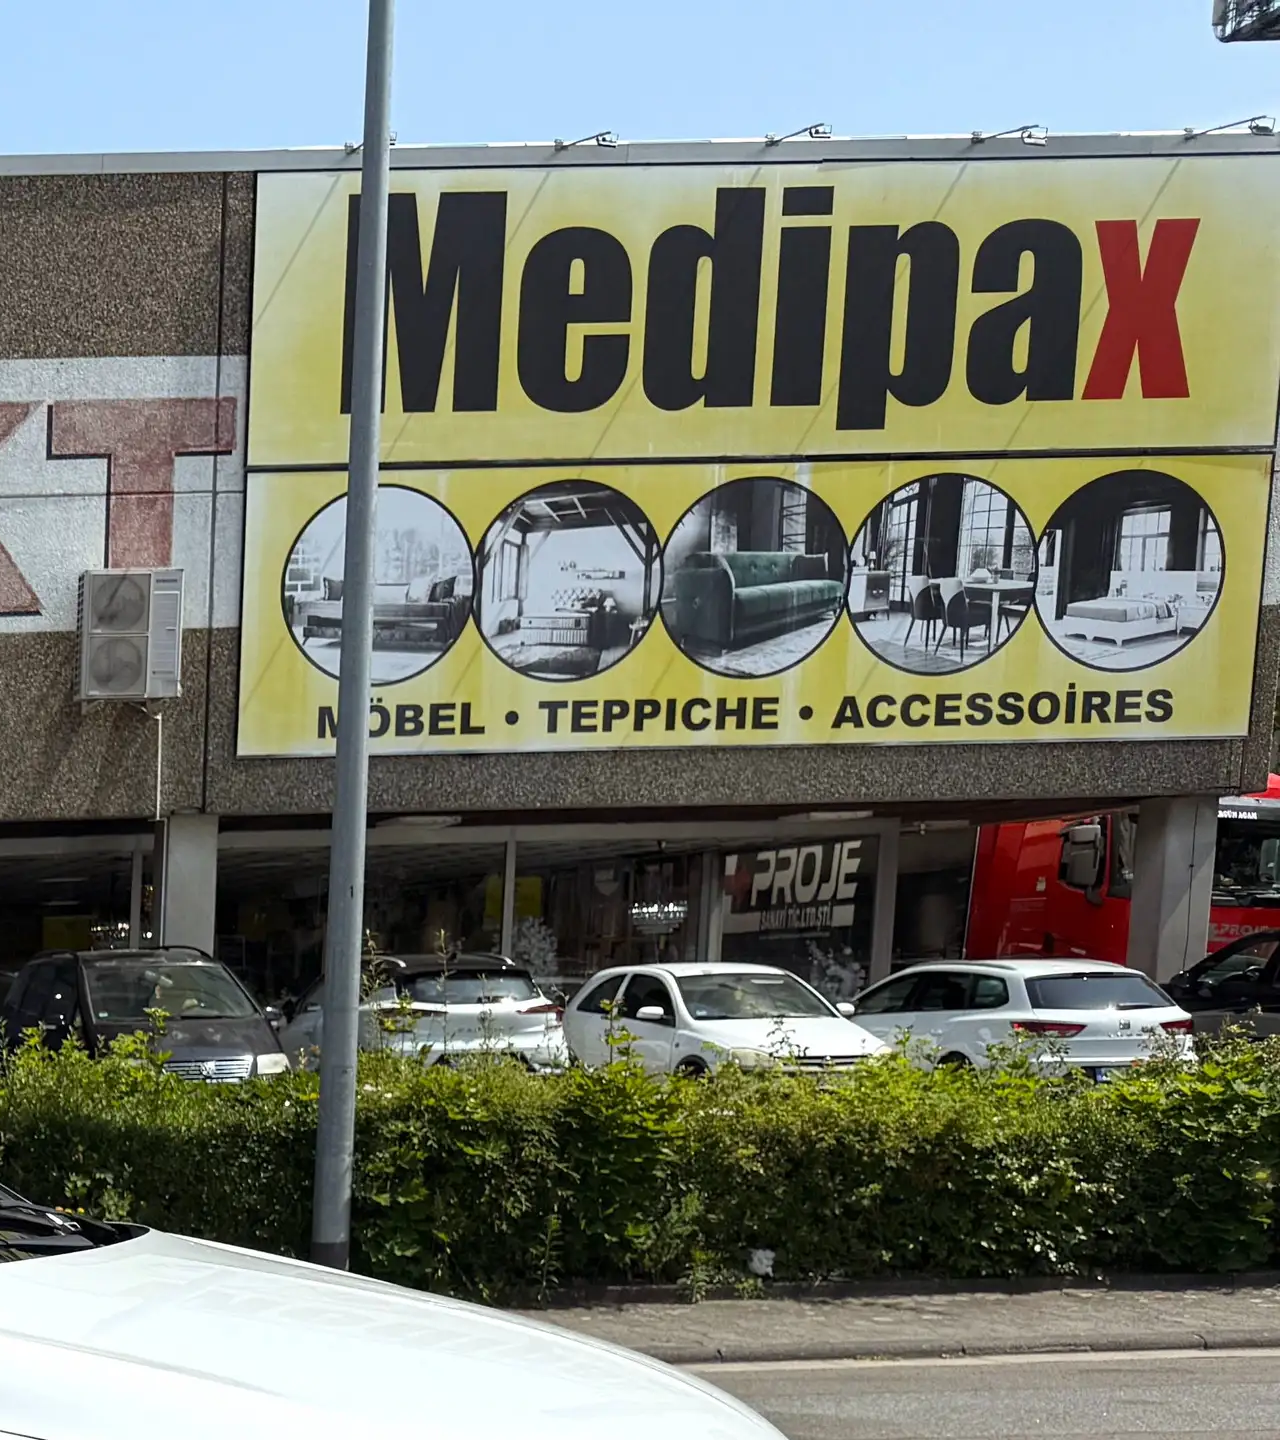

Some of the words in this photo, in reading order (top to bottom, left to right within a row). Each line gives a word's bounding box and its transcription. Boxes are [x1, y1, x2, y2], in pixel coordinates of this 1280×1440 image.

[341, 185, 1201, 431] Medipax
[539, 697, 780, 734] TEPPICHE
[750, 840, 862, 907] PROJE
